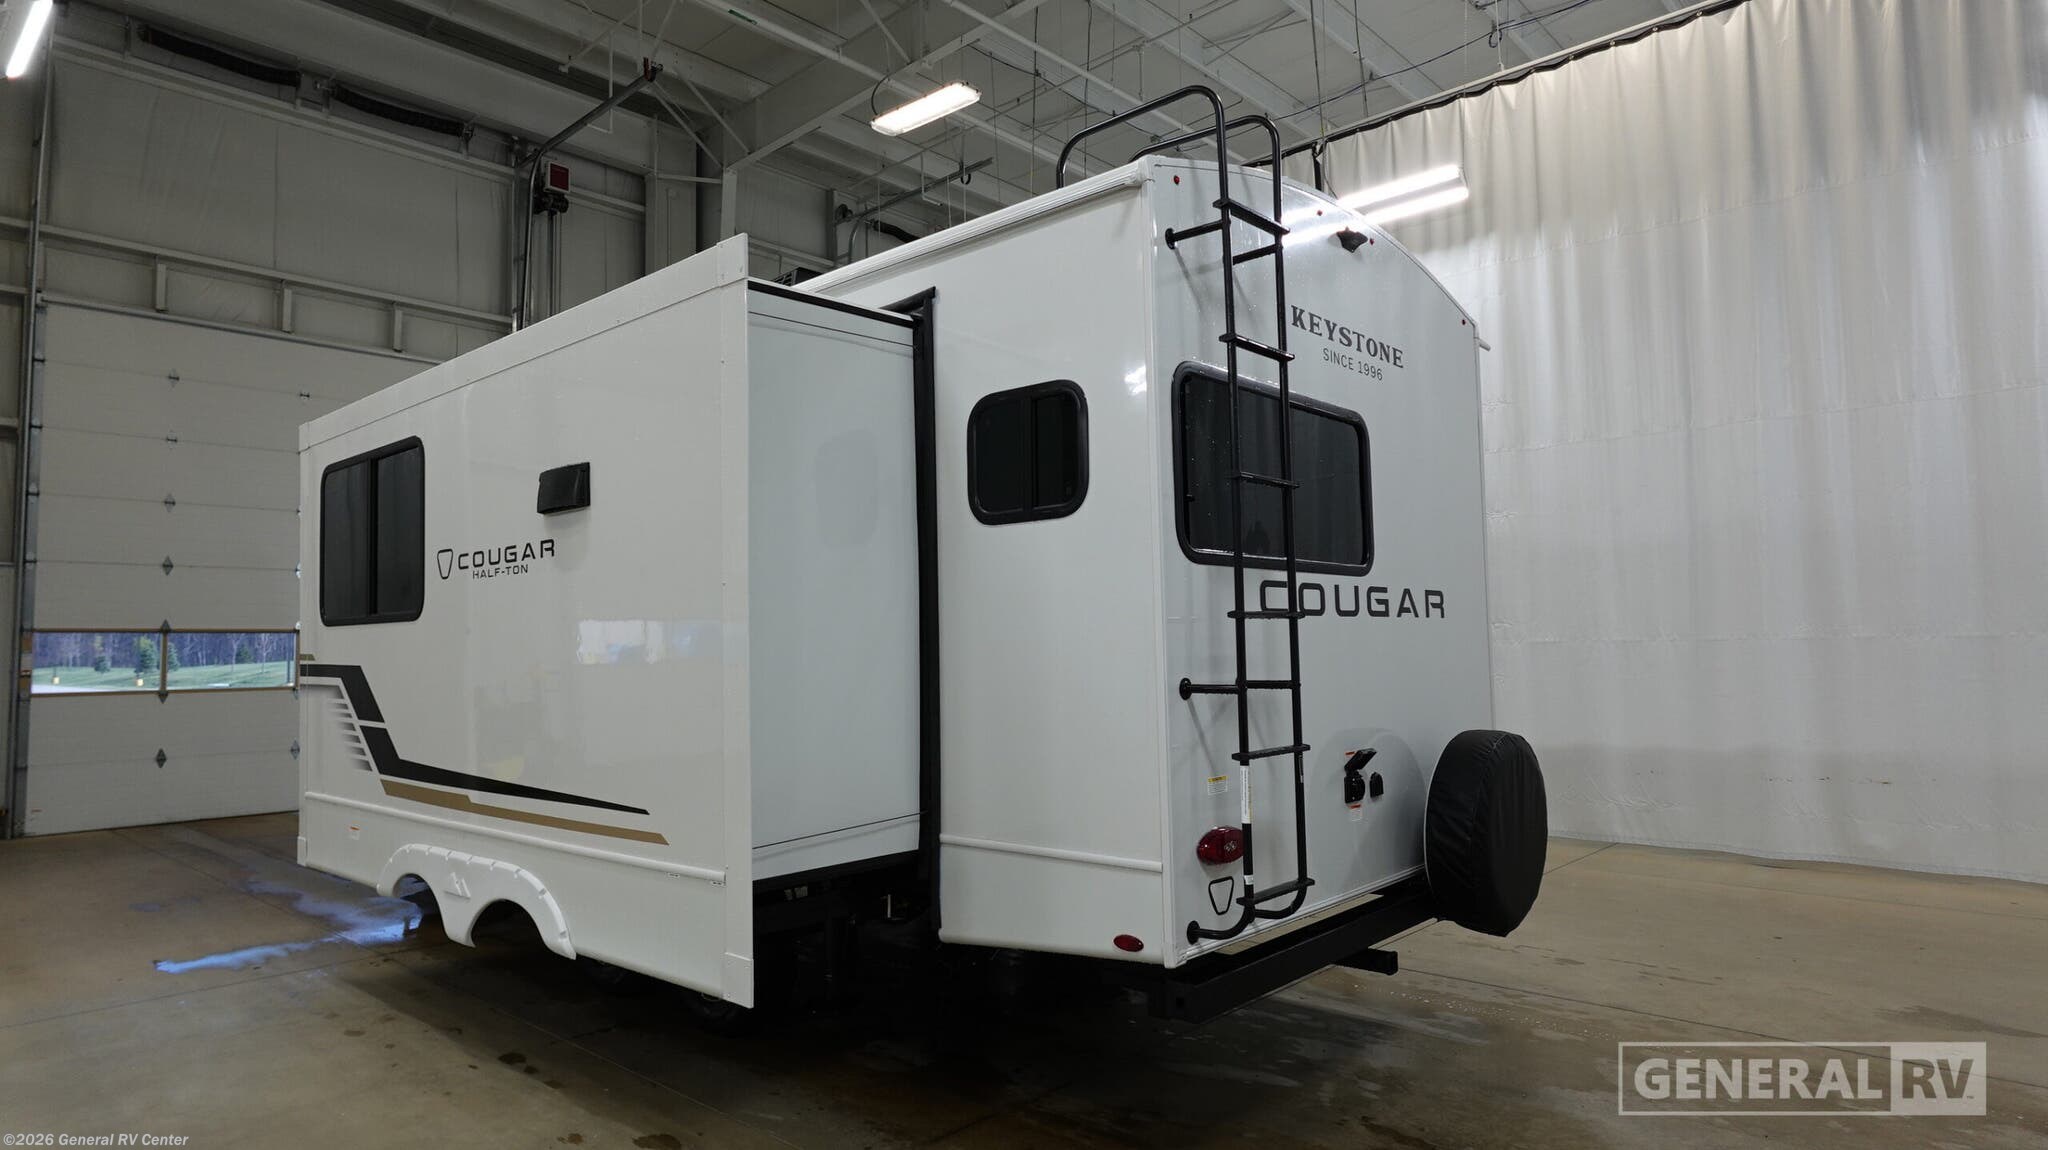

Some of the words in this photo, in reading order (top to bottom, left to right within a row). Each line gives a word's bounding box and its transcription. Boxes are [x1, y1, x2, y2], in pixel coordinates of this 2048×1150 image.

[1291, 305, 1404, 368] KEYSTONE
[1323, 347, 1354, 370] SINCE
[1358, 361, 1383, 380] 1996
[458, 539, 554, 570] COUGAR
[472, 564, 528, 580] HALF-TON
[1260, 580, 1445, 618] COUGAR
